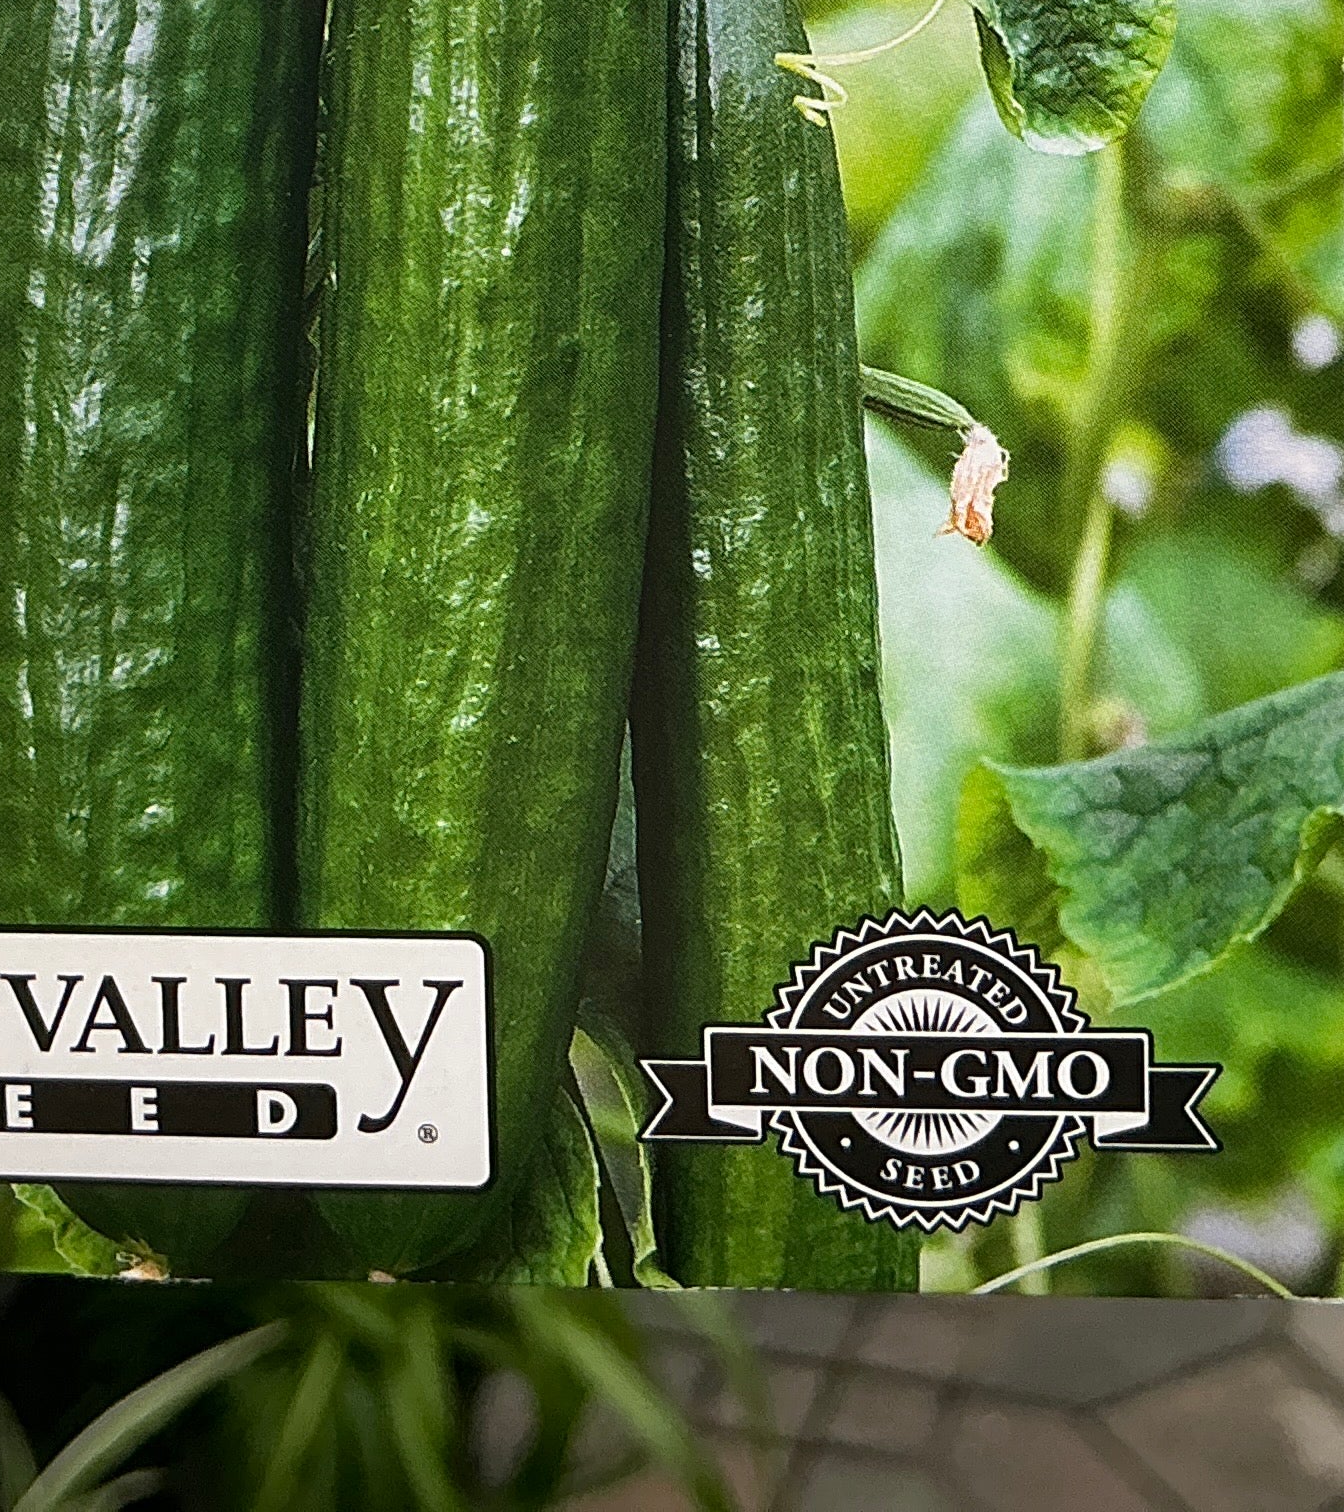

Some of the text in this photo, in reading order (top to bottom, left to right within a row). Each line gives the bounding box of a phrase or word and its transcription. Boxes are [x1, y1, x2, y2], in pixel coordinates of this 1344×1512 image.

[822, 953, 1030, 1027] UNTREATED
[0, 973, 465, 1134] VALLEY
[749, 1044, 1111, 1101] NON-GMO
[879, 1155, 982, 1191] SEED
